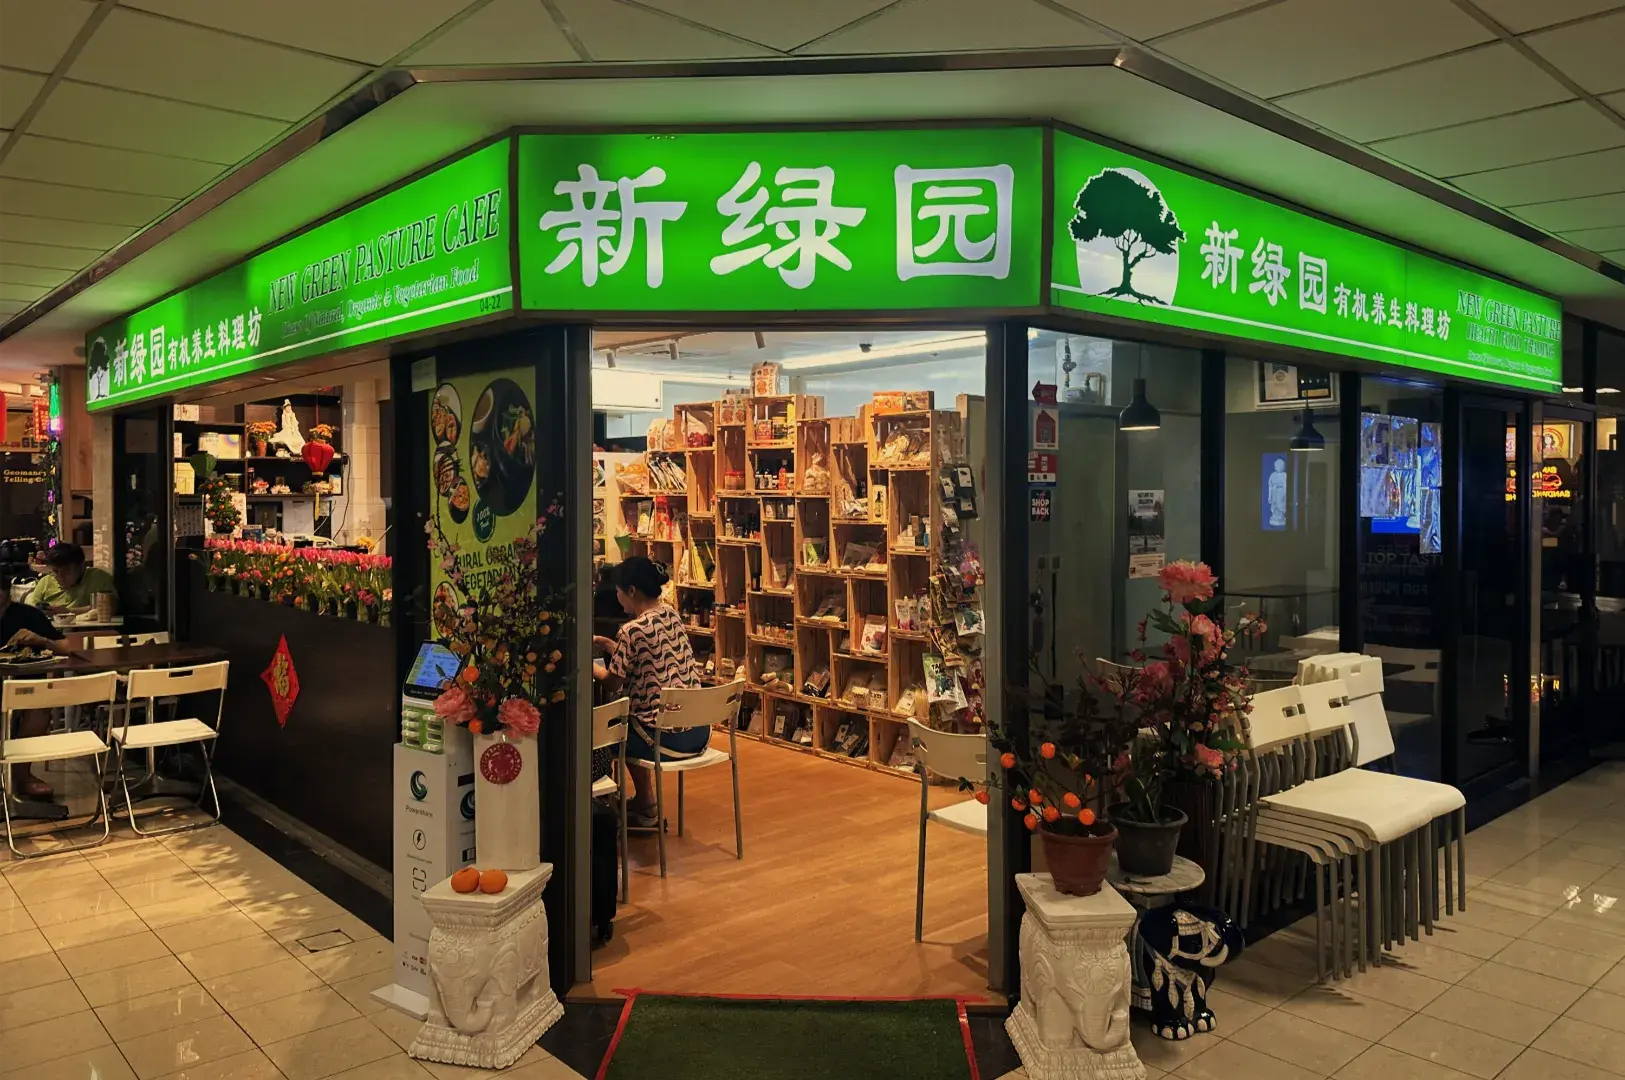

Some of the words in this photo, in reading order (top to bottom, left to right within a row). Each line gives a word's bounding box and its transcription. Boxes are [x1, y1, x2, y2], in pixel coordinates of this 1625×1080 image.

[539, 161, 1014, 289] 新绿园
[268, 271, 298, 315] NEW
[301, 250, 351, 304] GREEN
[353, 214, 437, 286] PASTURE
[442, 188, 501, 254] CAFE
[450, 258, 480, 290] Food
[1200, 220, 1328, 315] 新绿园
[1334, 282, 1452, 341] 有机养生料理坊
[480, 295, 501, 312] 04-22
[1456, 289, 1483, 320] NEW
[1485, 299, 1520, 330] GREEN
[1521, 309, 1561, 342] PASTURE
[113, 325, 165, 387] 新绿园
[168, 306, 262, 370] 有机养生料理坊
[3, 469, 47, 477] Geomancy
[1031, 498, 1050, 507] SHOP
[1031, 507, 1050, 516] BACK
